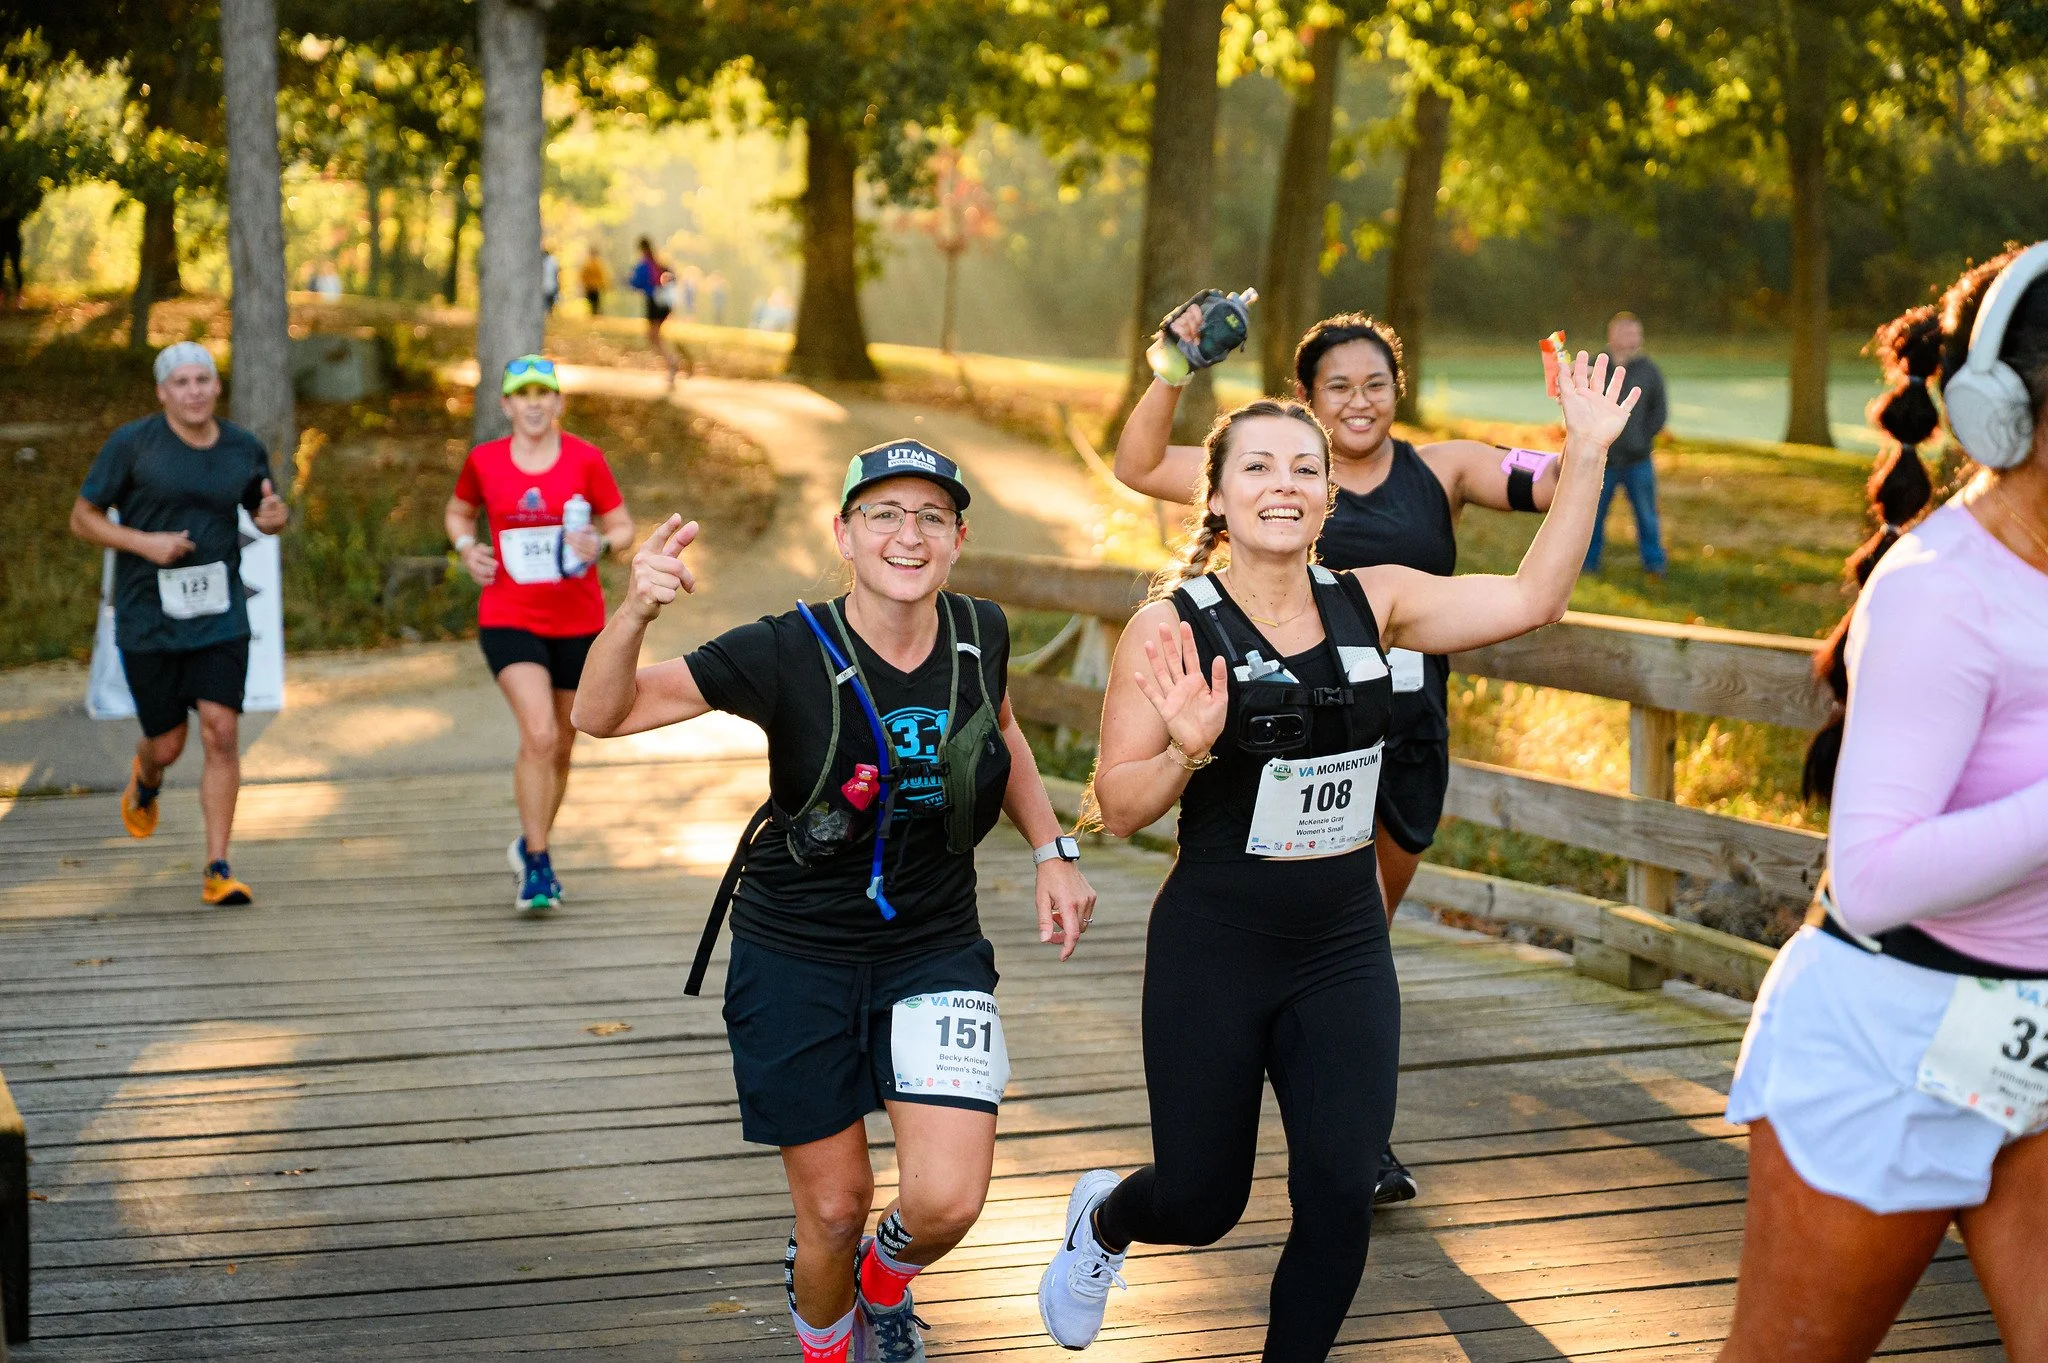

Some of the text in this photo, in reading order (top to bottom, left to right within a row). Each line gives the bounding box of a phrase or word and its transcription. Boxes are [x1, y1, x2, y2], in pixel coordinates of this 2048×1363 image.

[887, 448, 937, 466] UTMB
[181, 576, 209, 594] 123
[1298, 753, 1379, 778] VA MOMENTUM
[1300, 778, 1353, 814] 108
[1298, 815, 1345, 827] McKenzie Gray
[1296, 825, 1344, 836] Women's Small
[930, 996, 950, 1007] VA
[935, 1015, 991, 1053] 151
[939, 1053, 989, 1067] Becky Knicely
[936, 1063, 990, 1077] Women's Small
